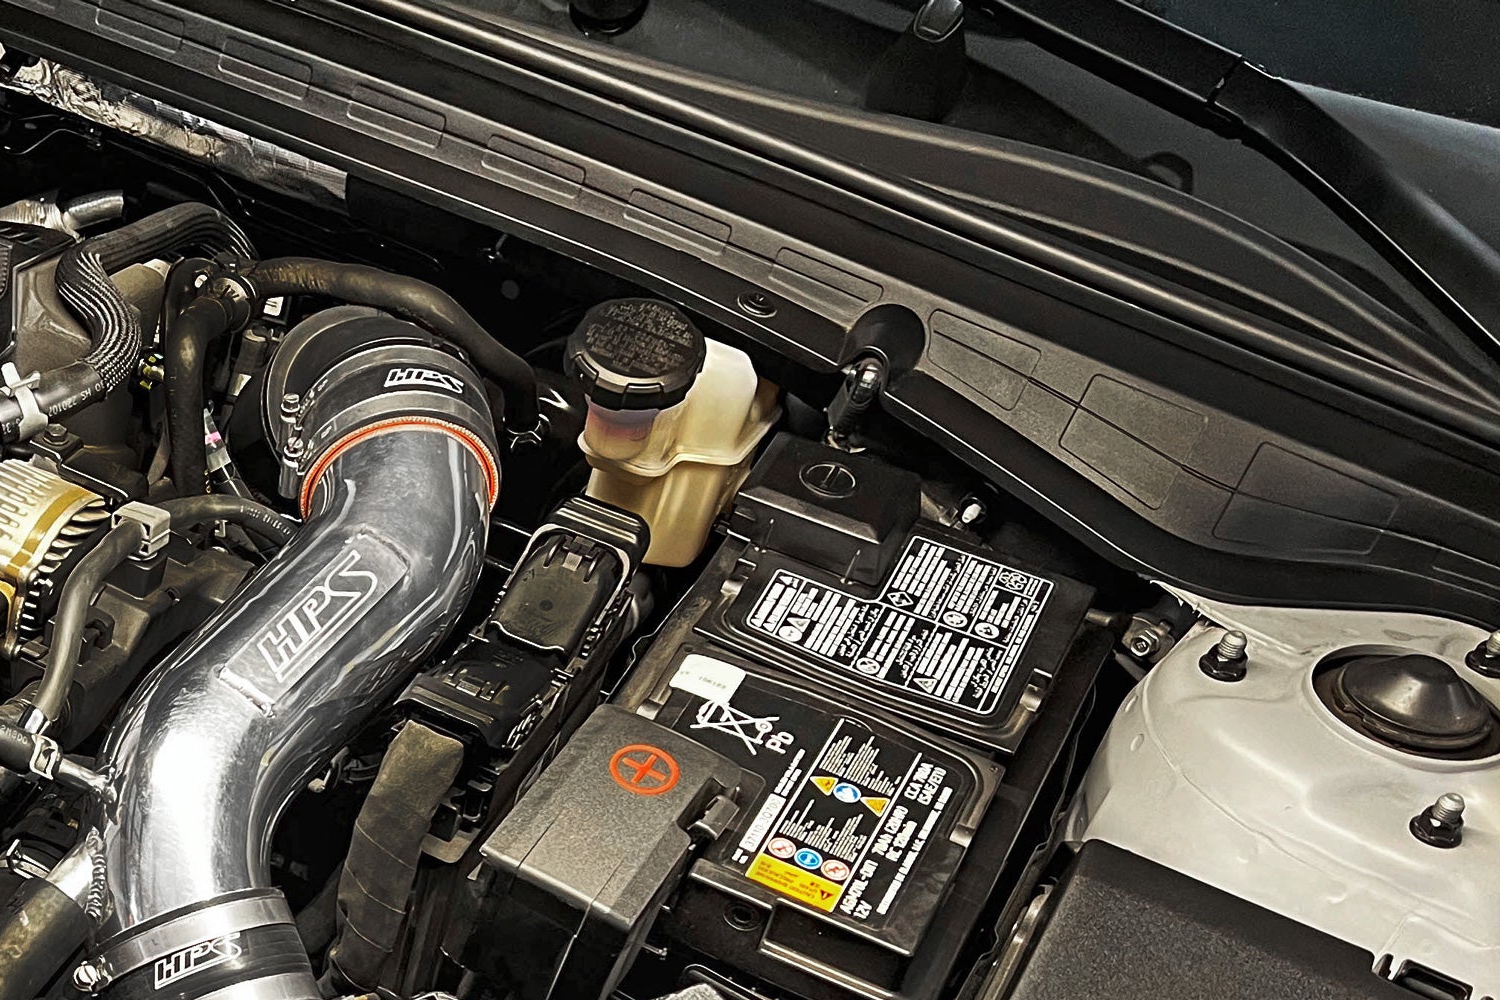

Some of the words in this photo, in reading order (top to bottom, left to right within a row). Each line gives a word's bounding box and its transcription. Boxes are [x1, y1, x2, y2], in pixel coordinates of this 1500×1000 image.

[383, 367, 464, 394] HPS
[256, 549, 378, 683] HPS
[765, 731, 794, 754] Pb
[853, 900, 873, 919] 12V
[154, 932, 242, 990] HPS
